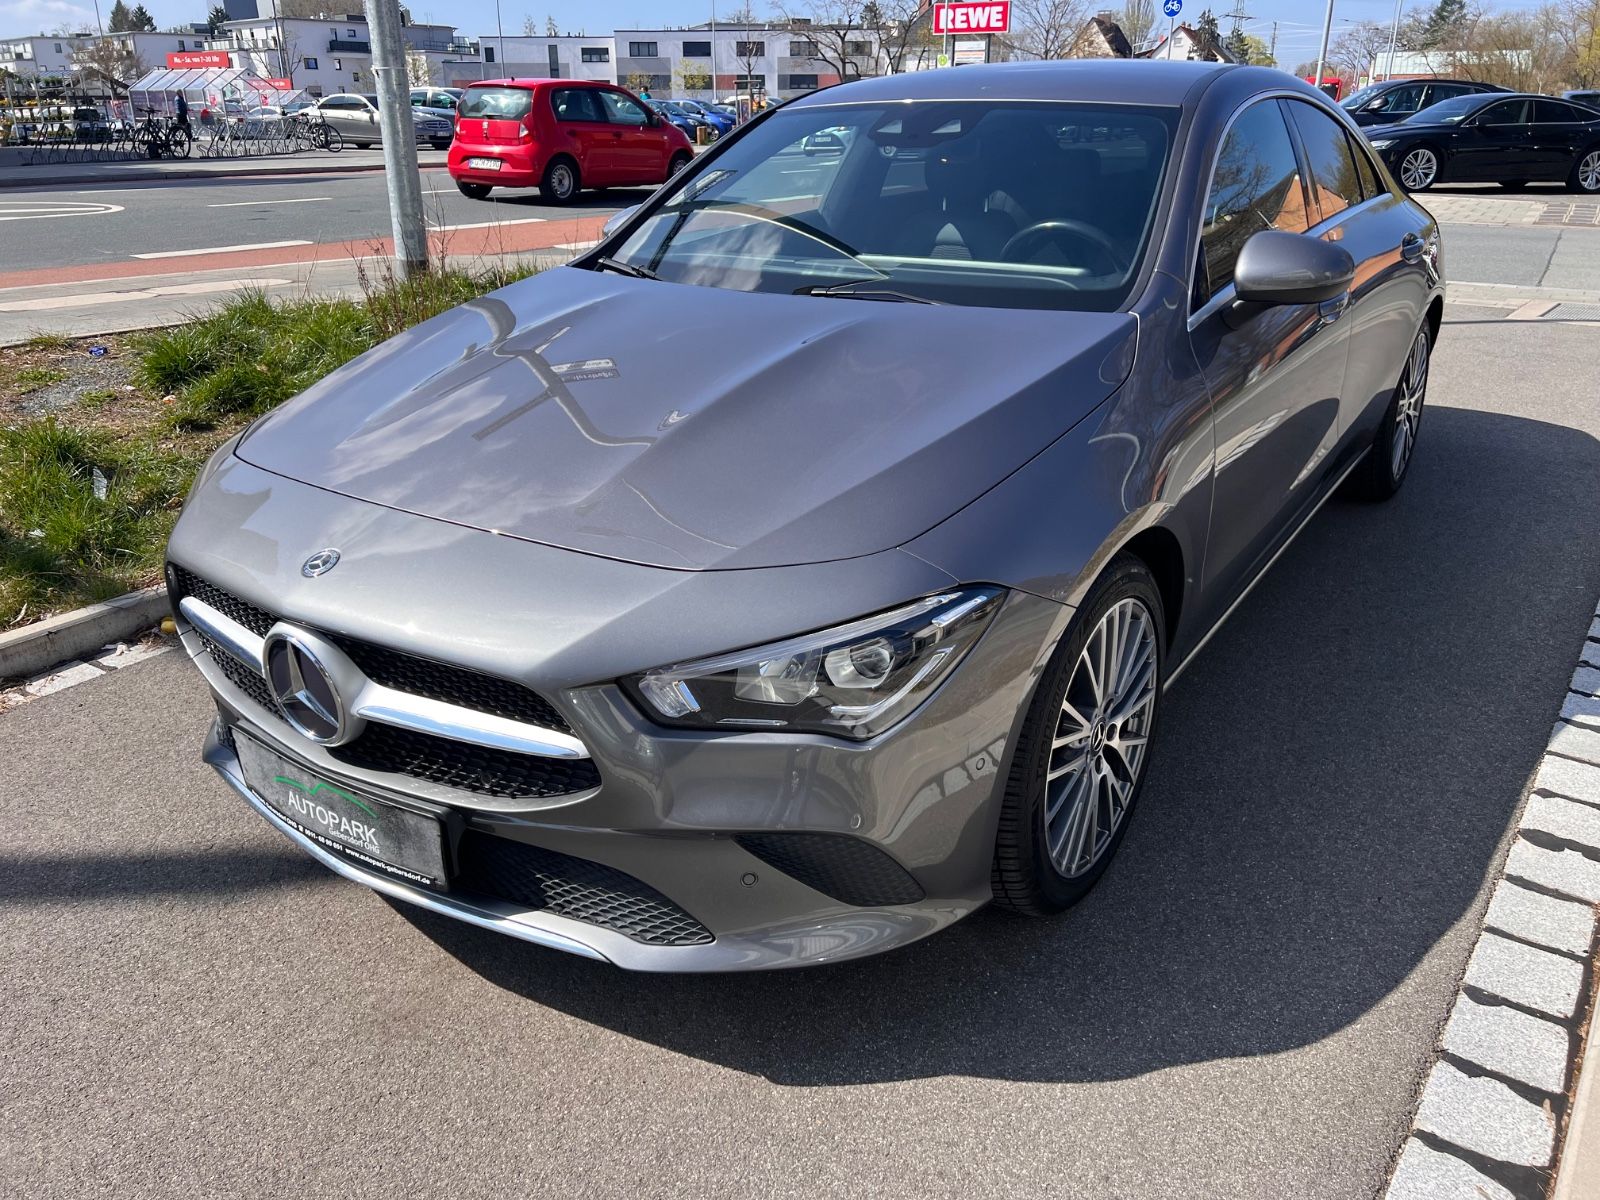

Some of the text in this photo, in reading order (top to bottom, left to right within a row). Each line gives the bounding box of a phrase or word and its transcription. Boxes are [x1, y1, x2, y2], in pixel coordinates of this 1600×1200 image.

[939, 6, 1004, 30] REWE
[288, 790, 379, 846] AUTOPARK
[329, 827, 380, 854] Gebersdorf OHG
[345, 848, 431, 885] www.autopark-gebersdorf.de
